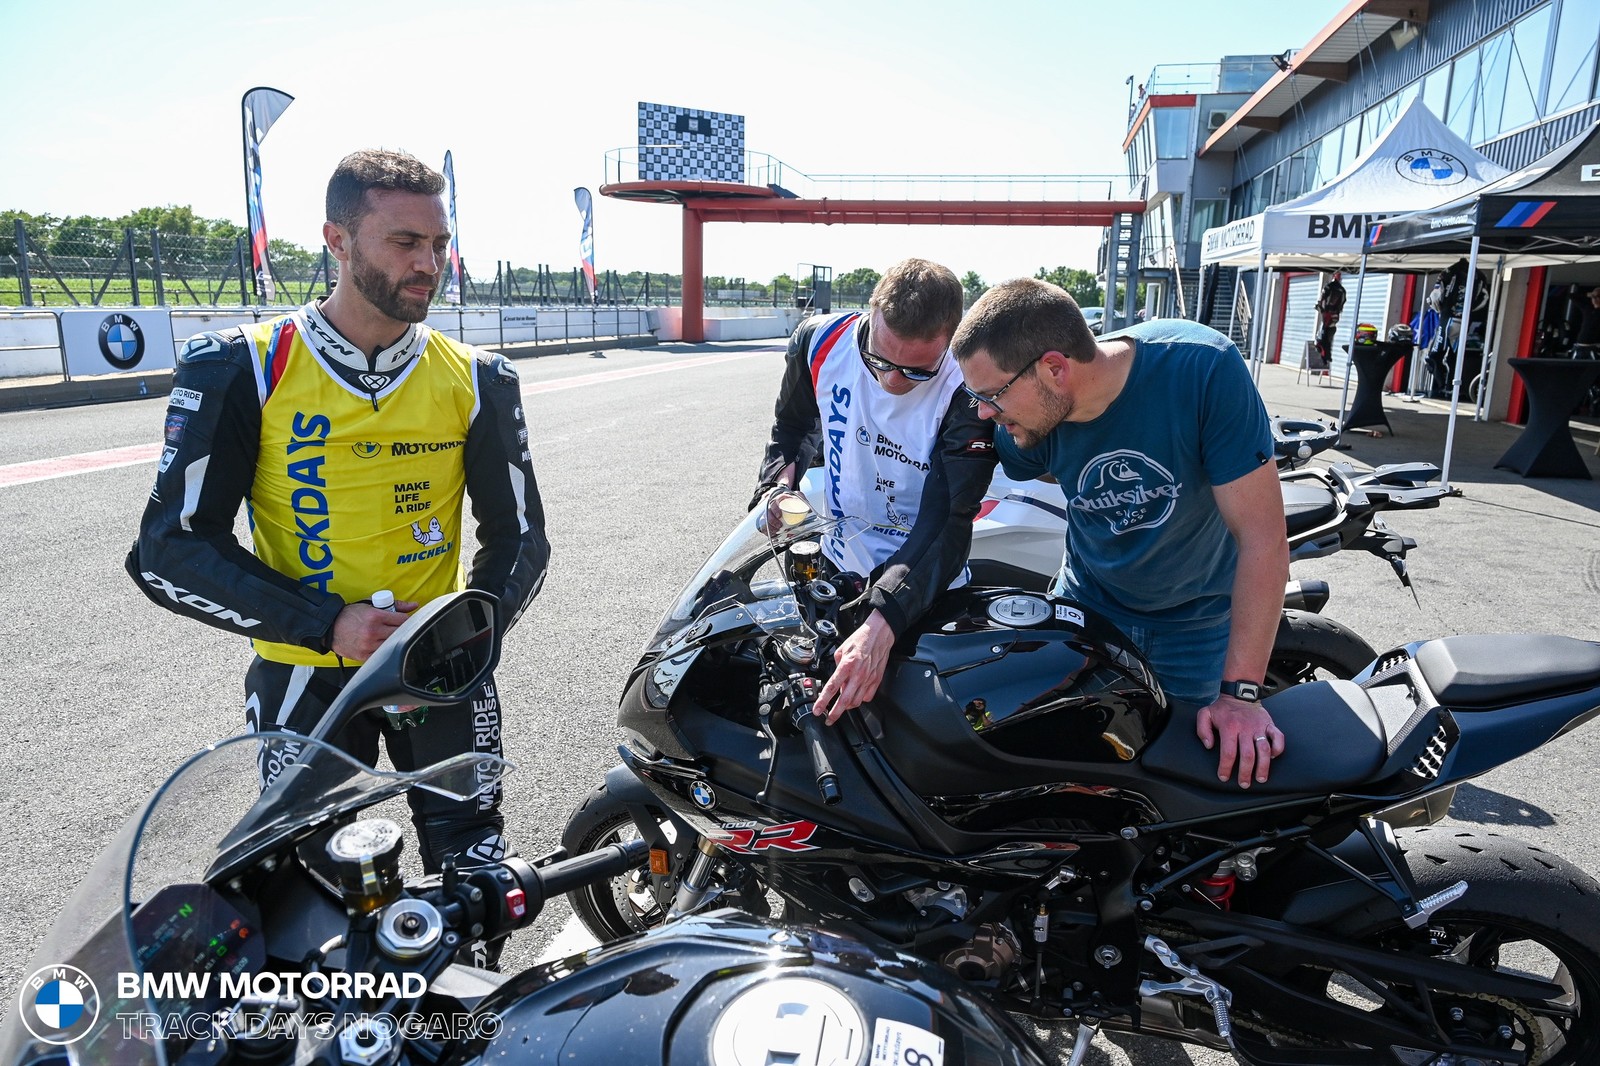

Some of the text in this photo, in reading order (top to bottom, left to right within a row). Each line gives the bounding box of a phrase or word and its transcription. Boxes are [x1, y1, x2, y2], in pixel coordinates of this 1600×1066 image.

[1402, 150, 1455, 163] BMW
[1220, 219, 1255, 248] MOTORRAD
[1307, 214, 1400, 239] BM
[101, 314, 138, 333] BMW
[170, 397, 185, 406] CING
[184, 390, 201, 401] RIDE
[391, 441, 465, 456] MOTORR
[394, 481, 430, 492] MAKE
[286, 411, 334, 598] ACKDAYS
[395, 493, 420, 503] LIFE
[1070, 482, 1183, 512] Quiksilver
[395, 501, 431, 514] A RIDE
[872, 526, 911, 538] MICH
[396, 541, 454, 565] MICHELI
[472, 699, 492, 747] RIDE
[178, 903, 193, 918] N
